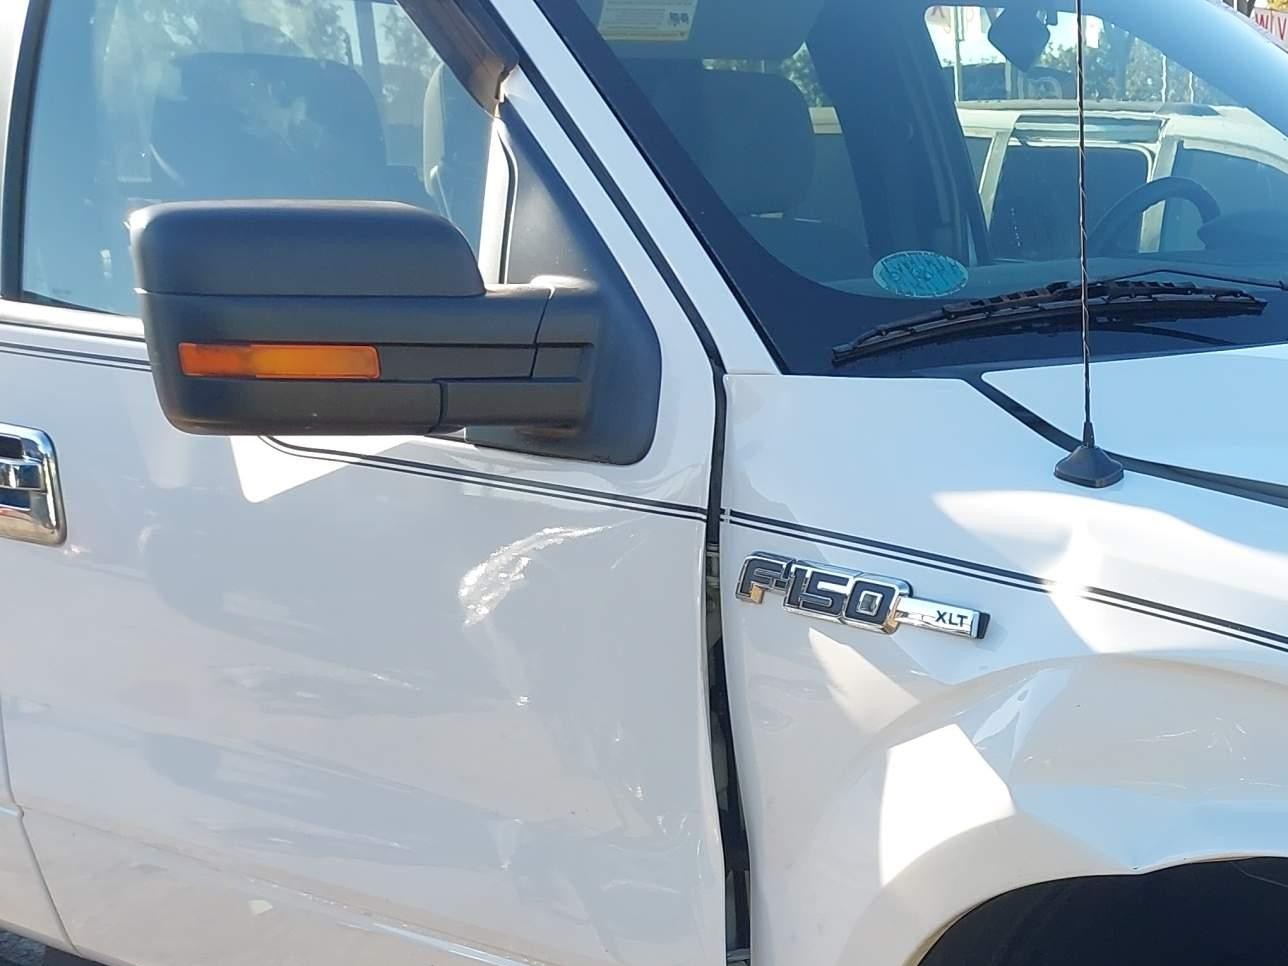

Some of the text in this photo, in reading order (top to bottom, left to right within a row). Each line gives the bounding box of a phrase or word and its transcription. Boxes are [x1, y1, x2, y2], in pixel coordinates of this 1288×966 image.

[1278, 16, 1288, 41] V
[735, 552, 968, 633] F-150 XLT
